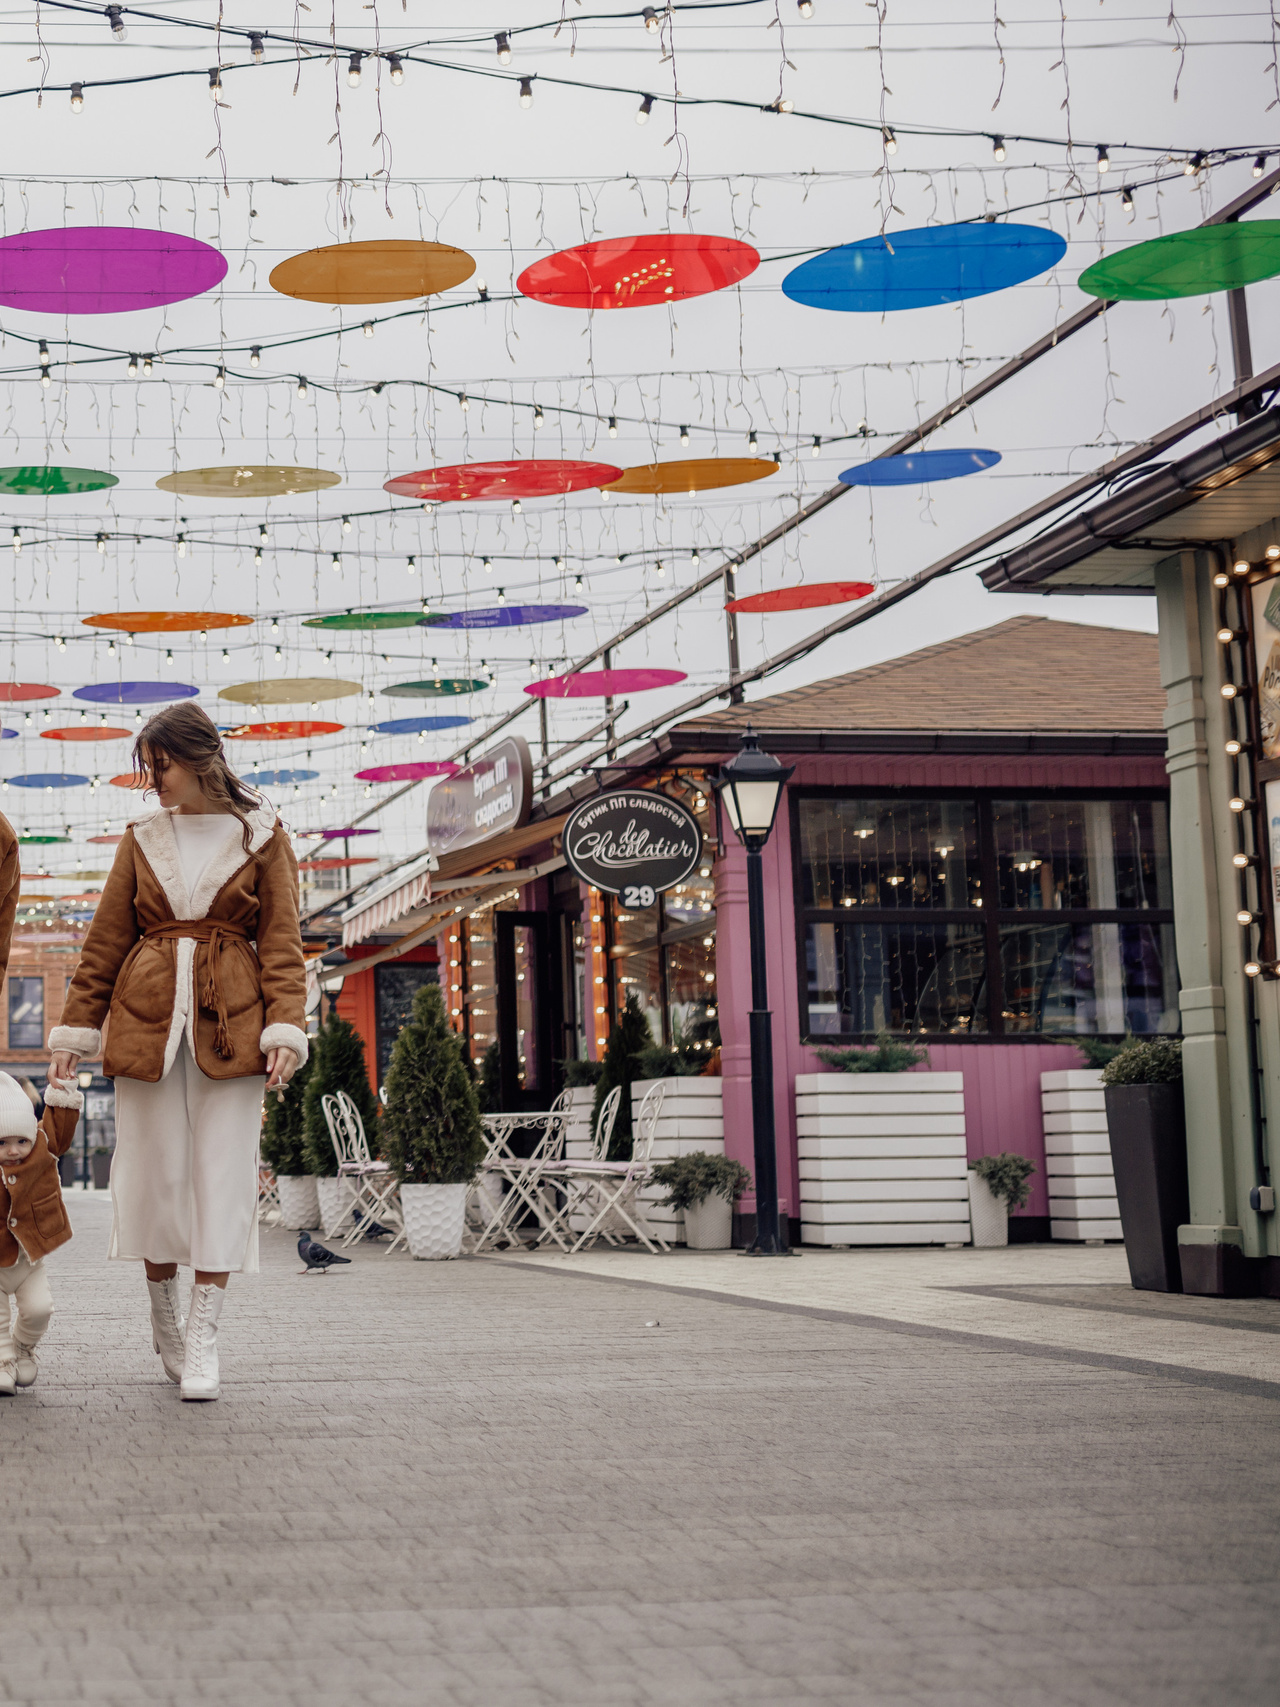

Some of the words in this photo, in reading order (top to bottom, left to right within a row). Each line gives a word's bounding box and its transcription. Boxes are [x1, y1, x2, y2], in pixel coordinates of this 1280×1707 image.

[495, 756, 508, 784] ПП
[475, 783, 514, 828] сладостей
[578, 803, 609, 829] Бутик
[609, 797, 627, 810] ПП
[629, 798, 687, 829] сладостей
[573, 829, 693, 867] Chocolatier
[624, 885, 655, 907] 29
